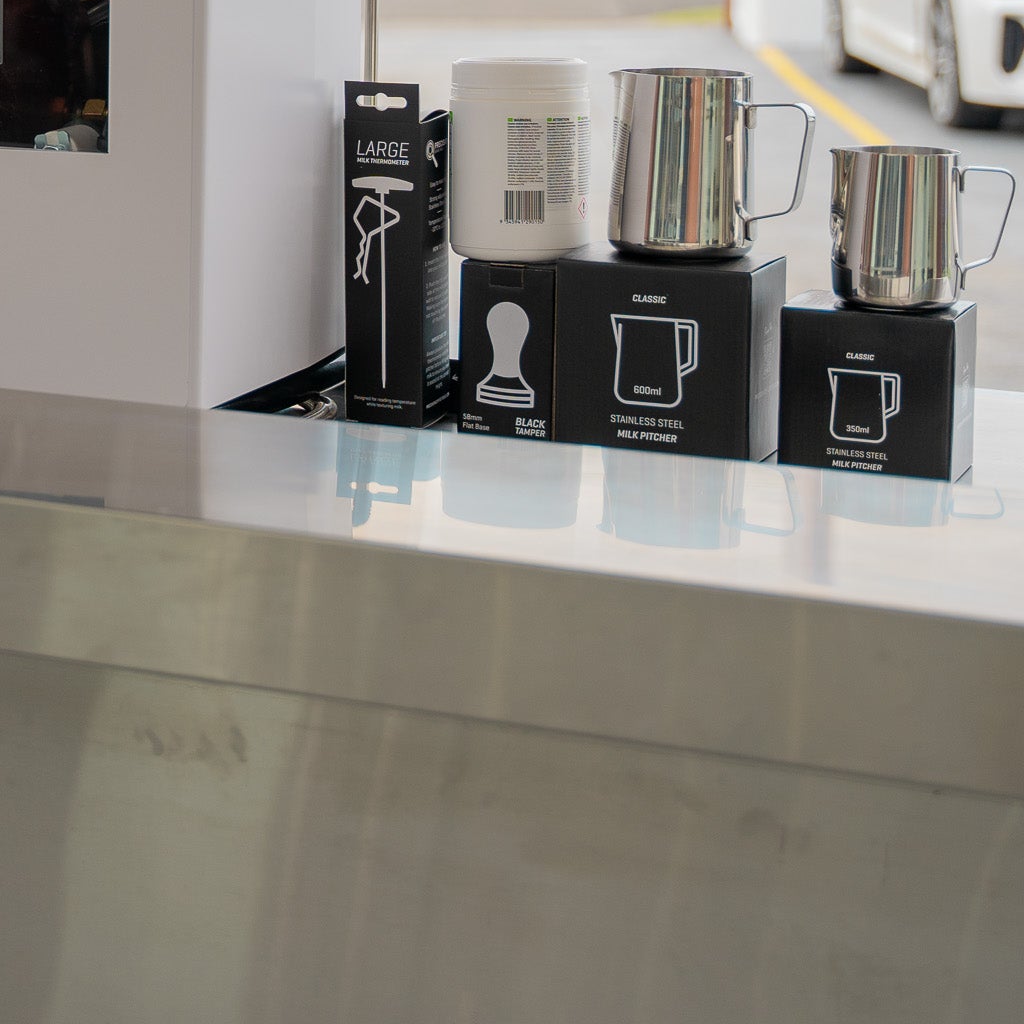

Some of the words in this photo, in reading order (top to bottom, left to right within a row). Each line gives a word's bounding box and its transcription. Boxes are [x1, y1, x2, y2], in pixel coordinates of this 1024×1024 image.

[356, 139, 410, 158] LARGE
[370, 157, 410, 166] THERMOMETER
[632, 293, 667, 304] CLASSIC
[845, 352, 875, 361] CLASSIC
[633, 385, 662, 396] 600ml
[462, 412, 483, 422] 58mm
[515, 416, 546, 429] BLACK
[610, 414, 656, 427] STAINLESS
[657, 418, 685, 430] STEEL
[462, 421, 474, 430] Flat
[475, 423, 490, 432] Base
[514, 426, 546, 438] TAMPER
[845, 424, 870, 434] 350ml
[616, 429, 639, 440] MILK
[639, 431, 678, 443] PITCHER
[826, 447, 865, 458] STAINLESS
[865, 451, 889, 461] STEEL
[831, 459, 851, 468] MILK
[851, 461, 883, 472] PITCHER
